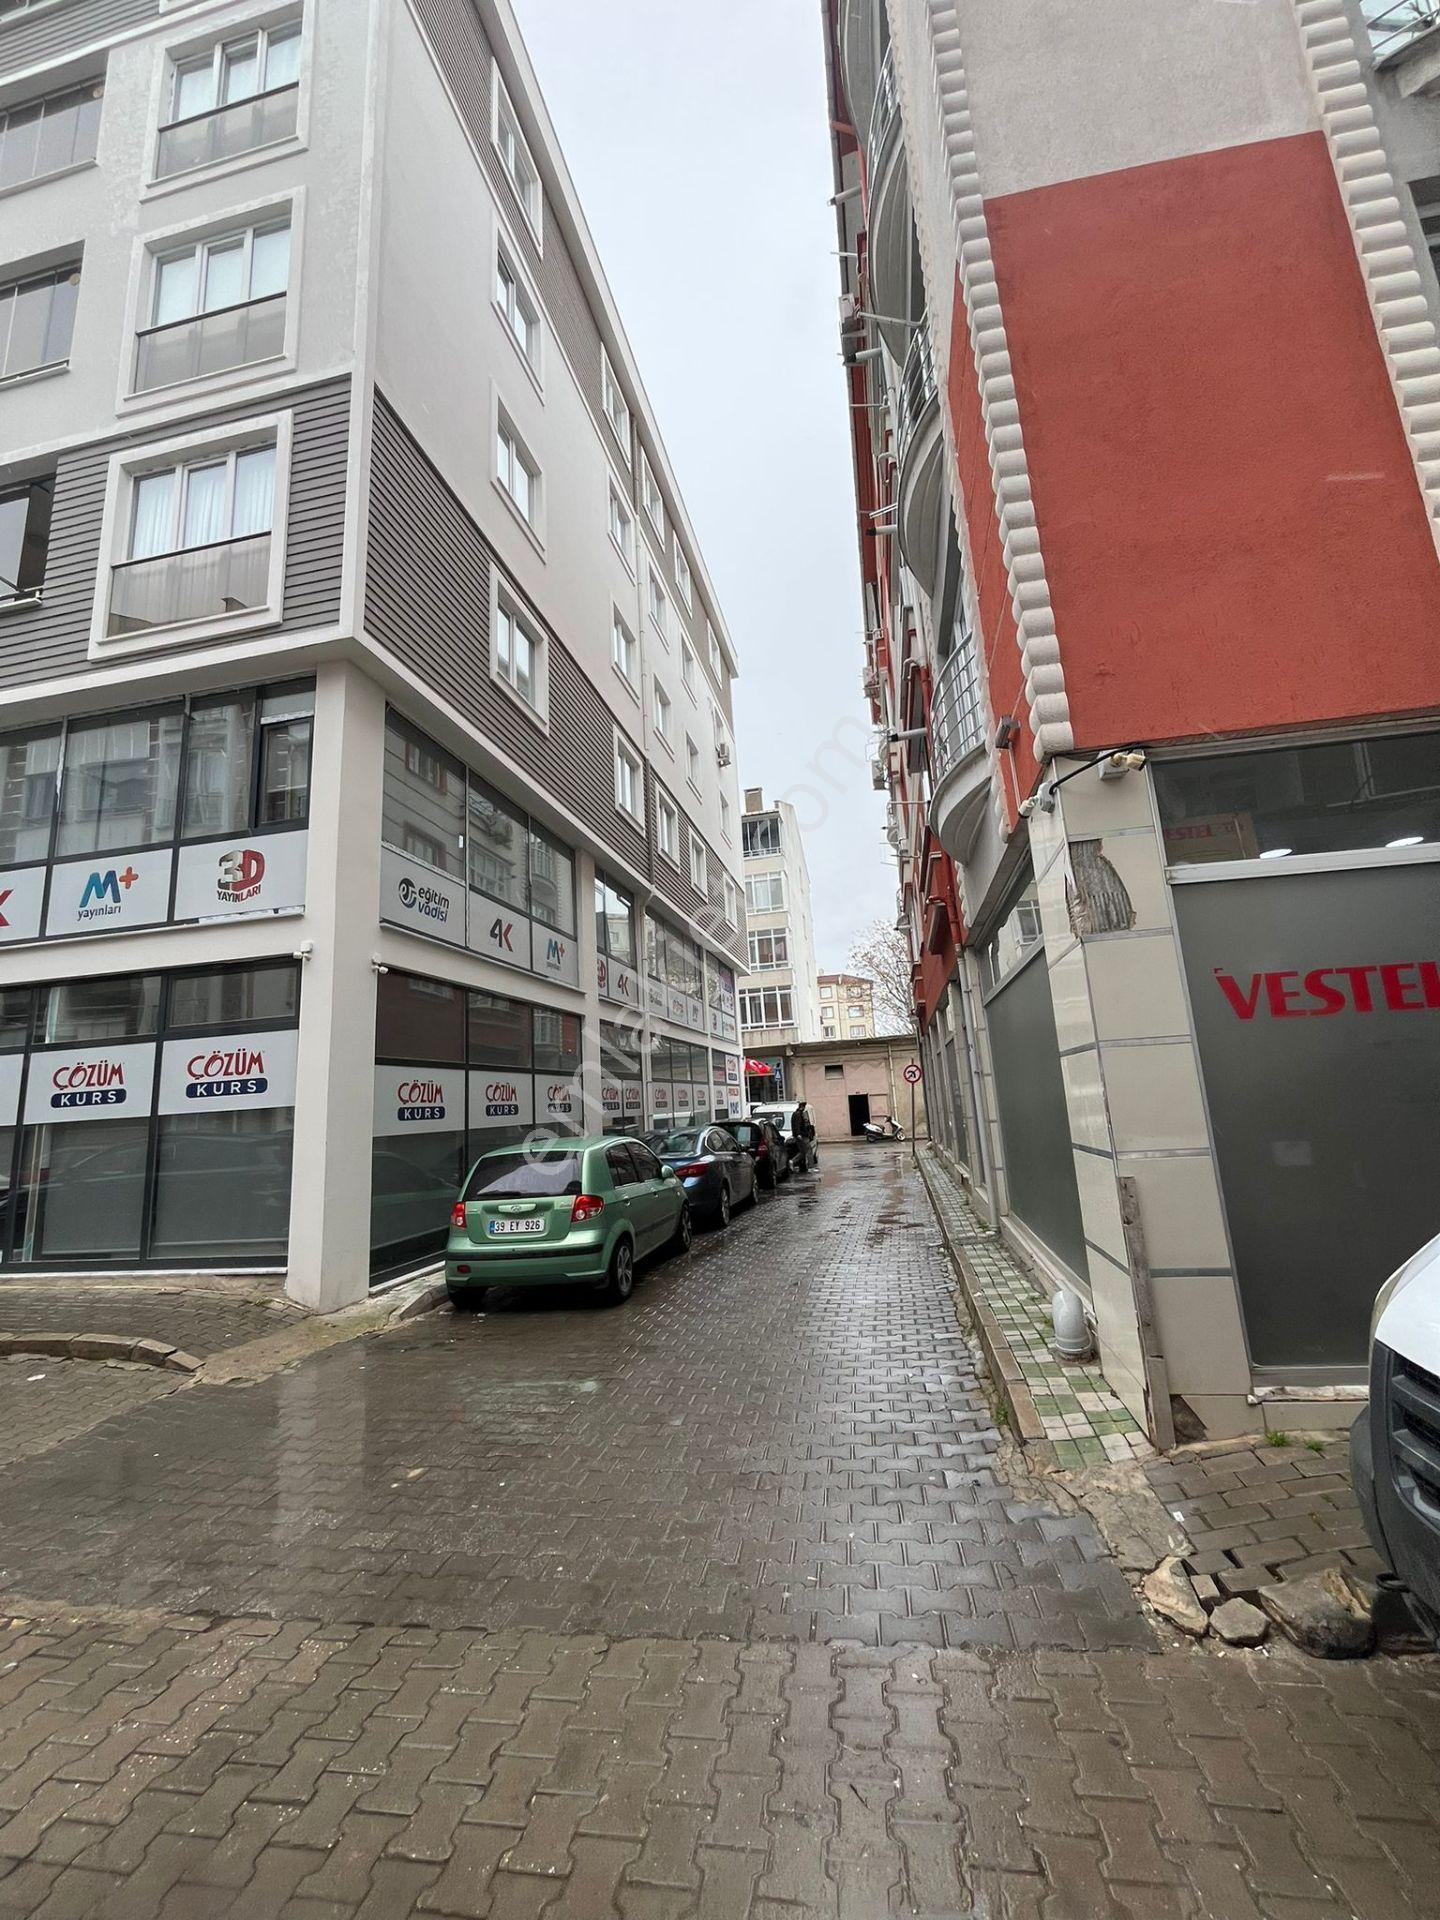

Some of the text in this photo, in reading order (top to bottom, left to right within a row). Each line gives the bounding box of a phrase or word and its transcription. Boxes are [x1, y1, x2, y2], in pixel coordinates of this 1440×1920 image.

[216, 849, 265, 891] 3D
[216, 884, 261, 903] YAYINLARI
[418, 886, 450, 909] eğitim
[77, 904, 122, 921] yayınları
[418, 901, 448, 922] vadisi
[490, 918, 513, 952] 4K
[187, 1048, 265, 1080] ÇÖZÜM
[52, 1060, 125, 1091] ÇÖZÜM
[60, 1090, 117, 1106] KURS
[197, 1079, 257, 1097] KURS
[398, 1080, 444, 1105] ÇÖZÜM
[485, 1082, 518, 1103] ÇÖZÜM
[404, 1107, 441, 1120] KURS
[490, 1105, 516, 1116] KURS
[495, 1221, 505, 1231] 39
[510, 1221, 520, 1231] EY
[525, 1220, 541, 1230] 926
